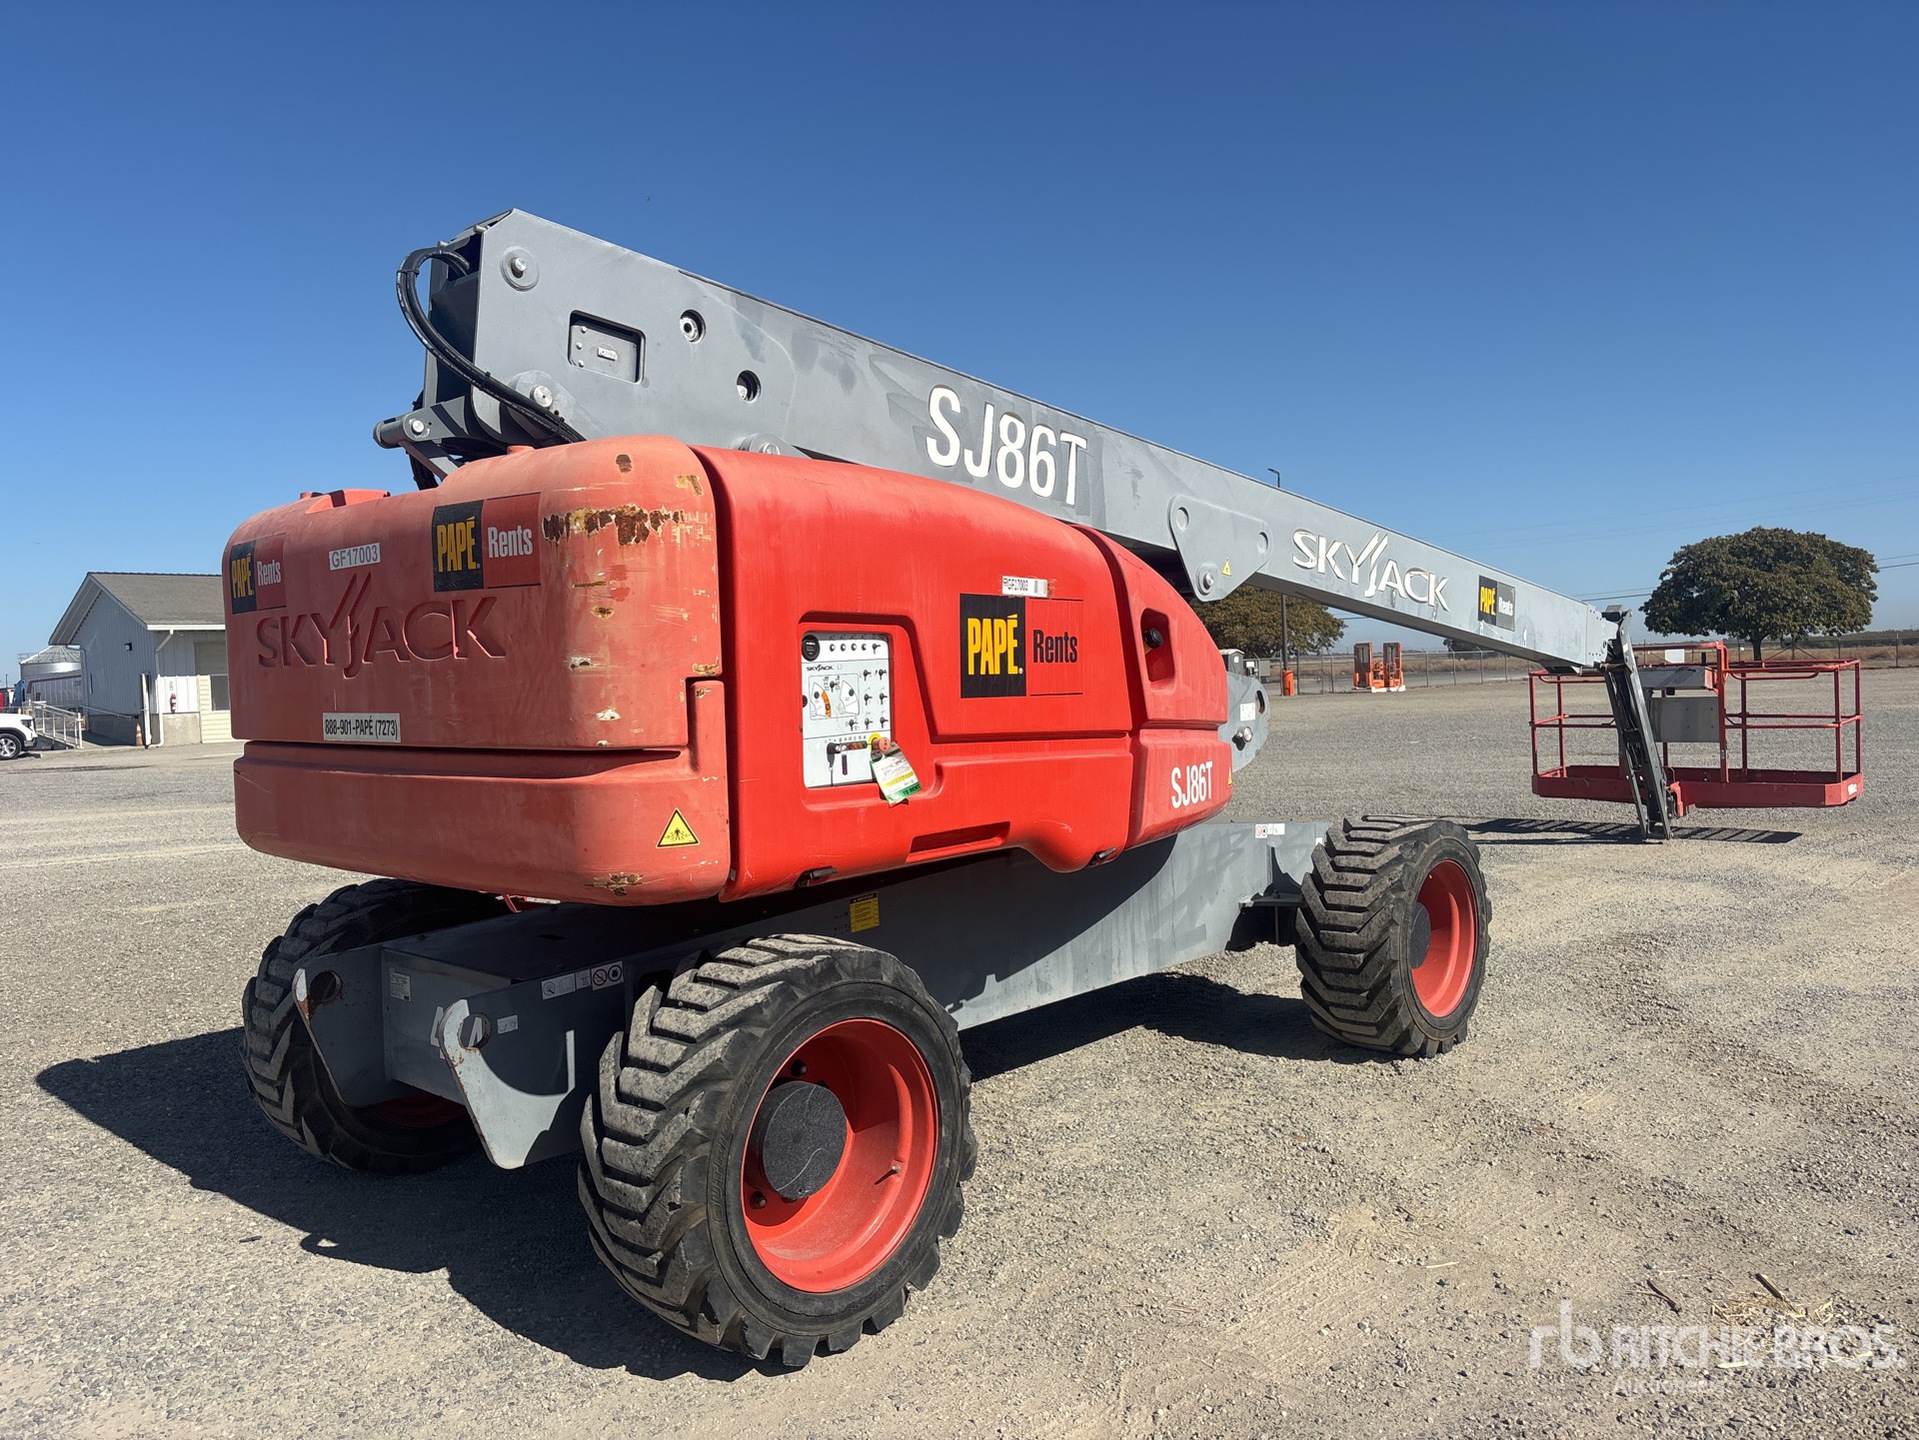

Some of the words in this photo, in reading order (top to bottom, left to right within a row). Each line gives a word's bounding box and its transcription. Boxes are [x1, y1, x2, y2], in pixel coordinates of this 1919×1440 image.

[926, 384, 1088, 506] SJ86T
[331, 544, 378, 569] GF17003
[487, 525, 533, 559] Rents
[256, 559, 281, 586] Rents
[1291, 530, 1451, 613] SKYJACK
[1498, 596, 1514, 617] Rents
[256, 571, 507, 680] SKYJACK
[1032, 628, 1078, 664] Rents
[325, 715, 374, 736] 888-901-PAPÉ
[375, 719, 398, 740] (7273)
[1171, 761, 1213, 809] SJ86T
